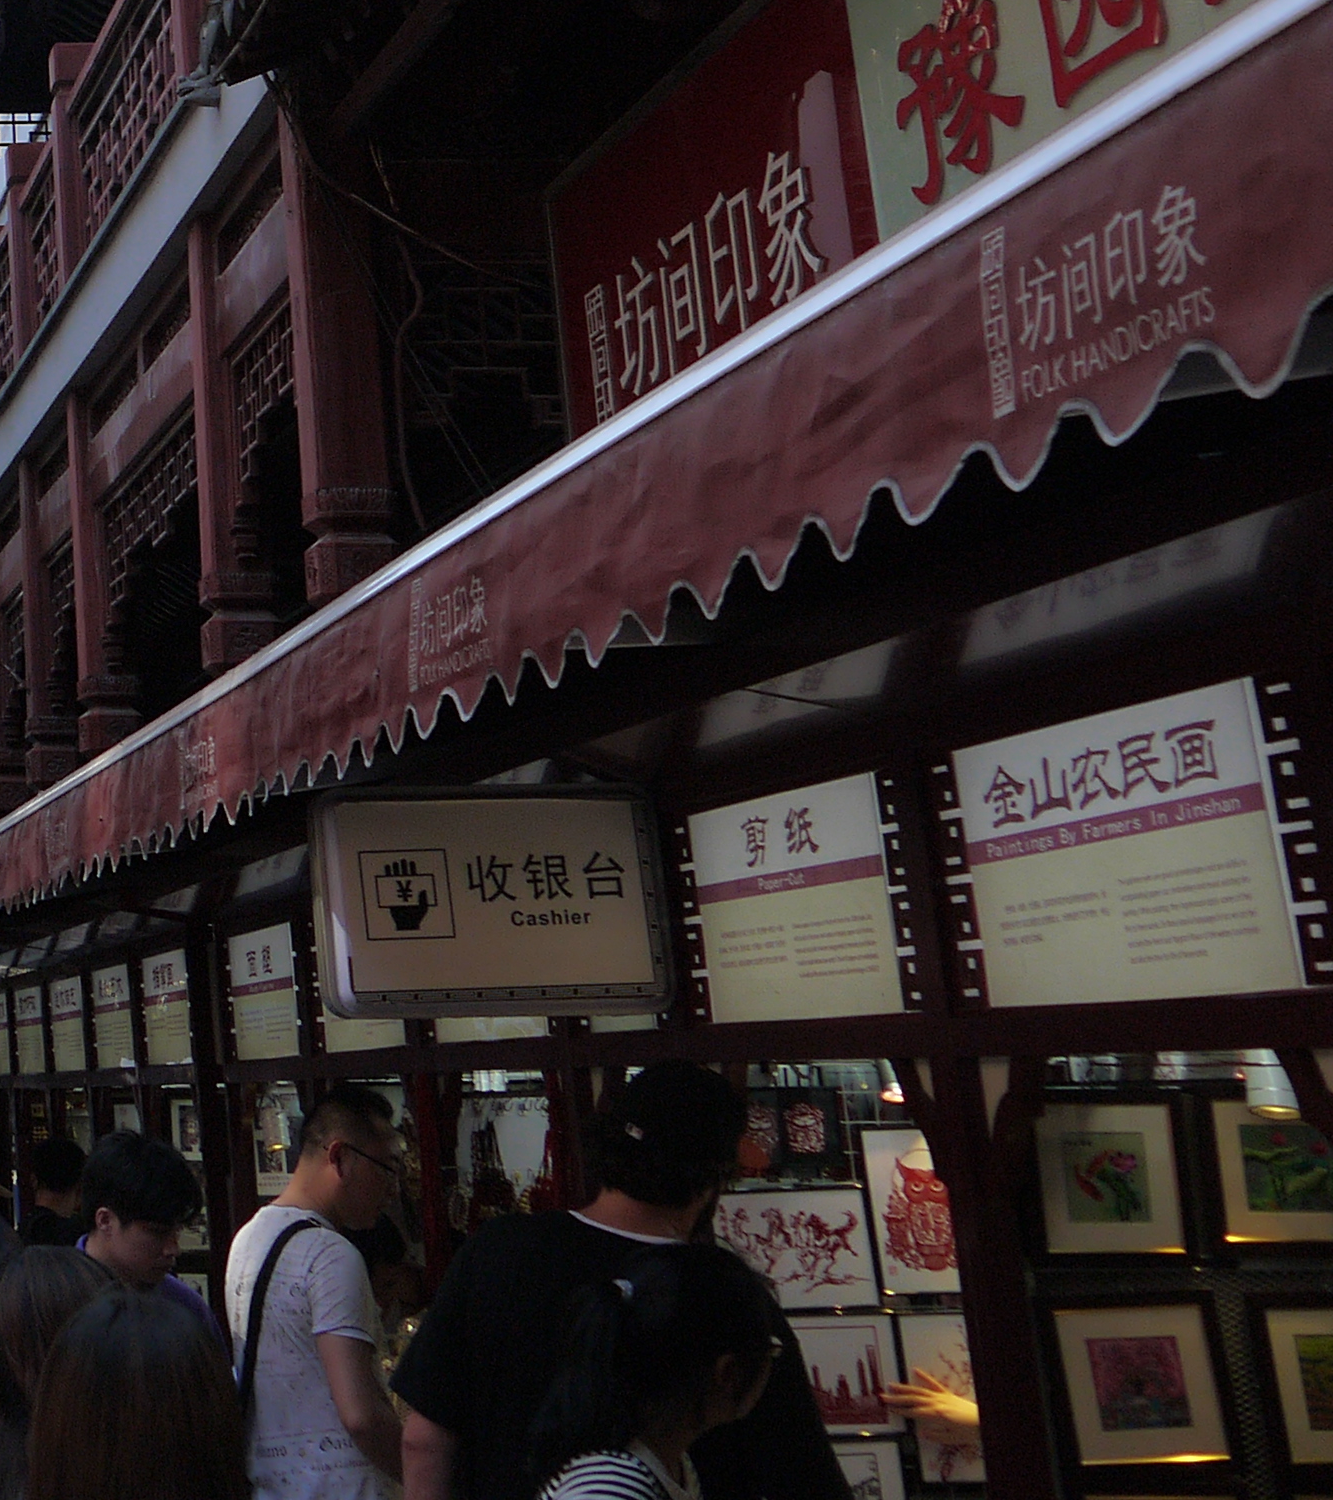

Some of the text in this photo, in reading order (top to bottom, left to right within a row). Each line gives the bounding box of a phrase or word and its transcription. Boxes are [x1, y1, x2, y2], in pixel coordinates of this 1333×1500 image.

[613, 150, 827, 396] 坊间印象
[1015, 184, 1208, 352] 坊间印象
[1021, 286, 1216, 403] FOLK HANDICRAFTS
[420, 574, 488, 657] 坊间印象
[983, 719, 1220, 829] 金山农民画
[740, 806, 820, 868] 剪纸
[986, 796, 1242, 859] Paintings By Farmers In Jinshan
[466, 850, 626, 903] 收银台
[510, 908, 592, 927] Cashier
